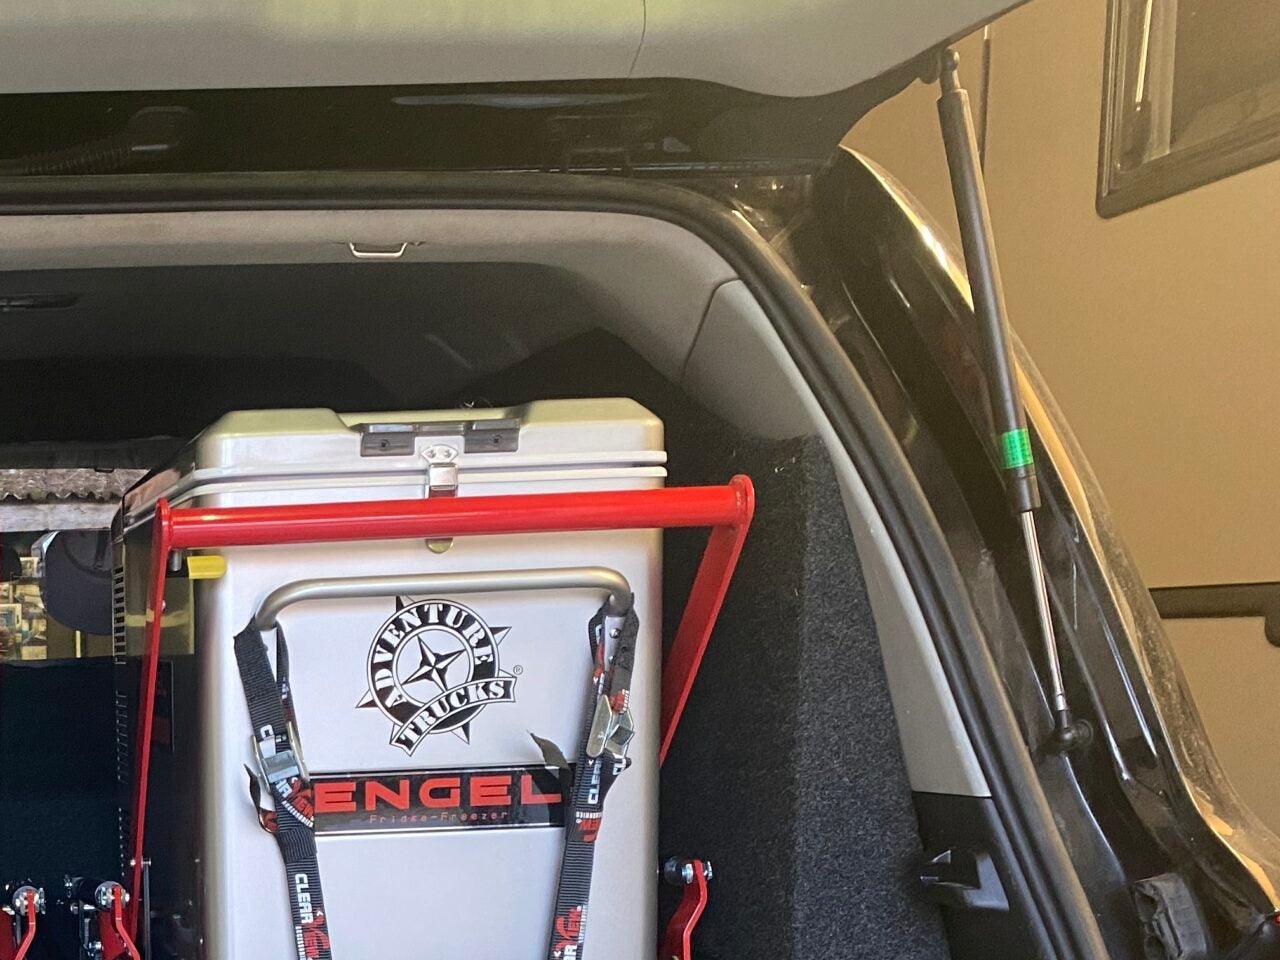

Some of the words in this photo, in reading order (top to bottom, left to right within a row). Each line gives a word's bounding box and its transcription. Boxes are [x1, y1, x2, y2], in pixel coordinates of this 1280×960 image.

[373, 603, 494, 708] ADVENTURE
[400, 680, 505, 744] TRUCKS
[314, 774, 562, 813] ENGEL
